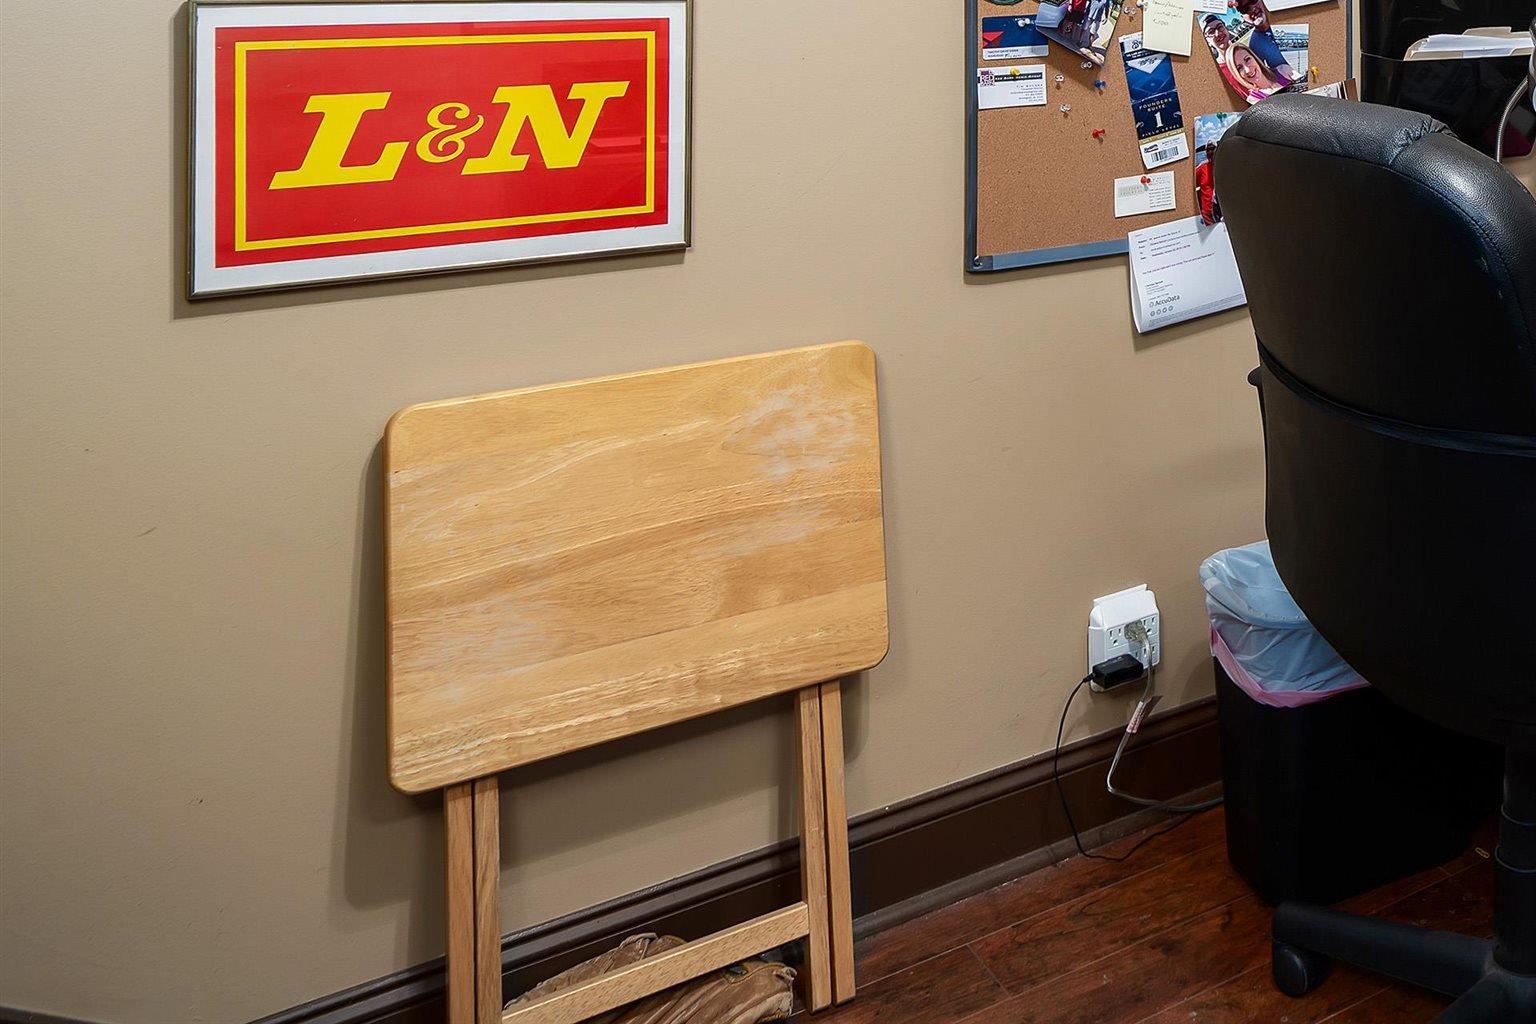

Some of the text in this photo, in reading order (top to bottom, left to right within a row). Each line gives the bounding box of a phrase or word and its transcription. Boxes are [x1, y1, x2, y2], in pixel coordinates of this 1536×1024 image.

[1139, 97, 1172, 110] FOUNDERS
[1147, 104, 1166, 112] SUITE
[1154, 111, 1164, 128] 1
[268, 80, 630, 189] L&N
